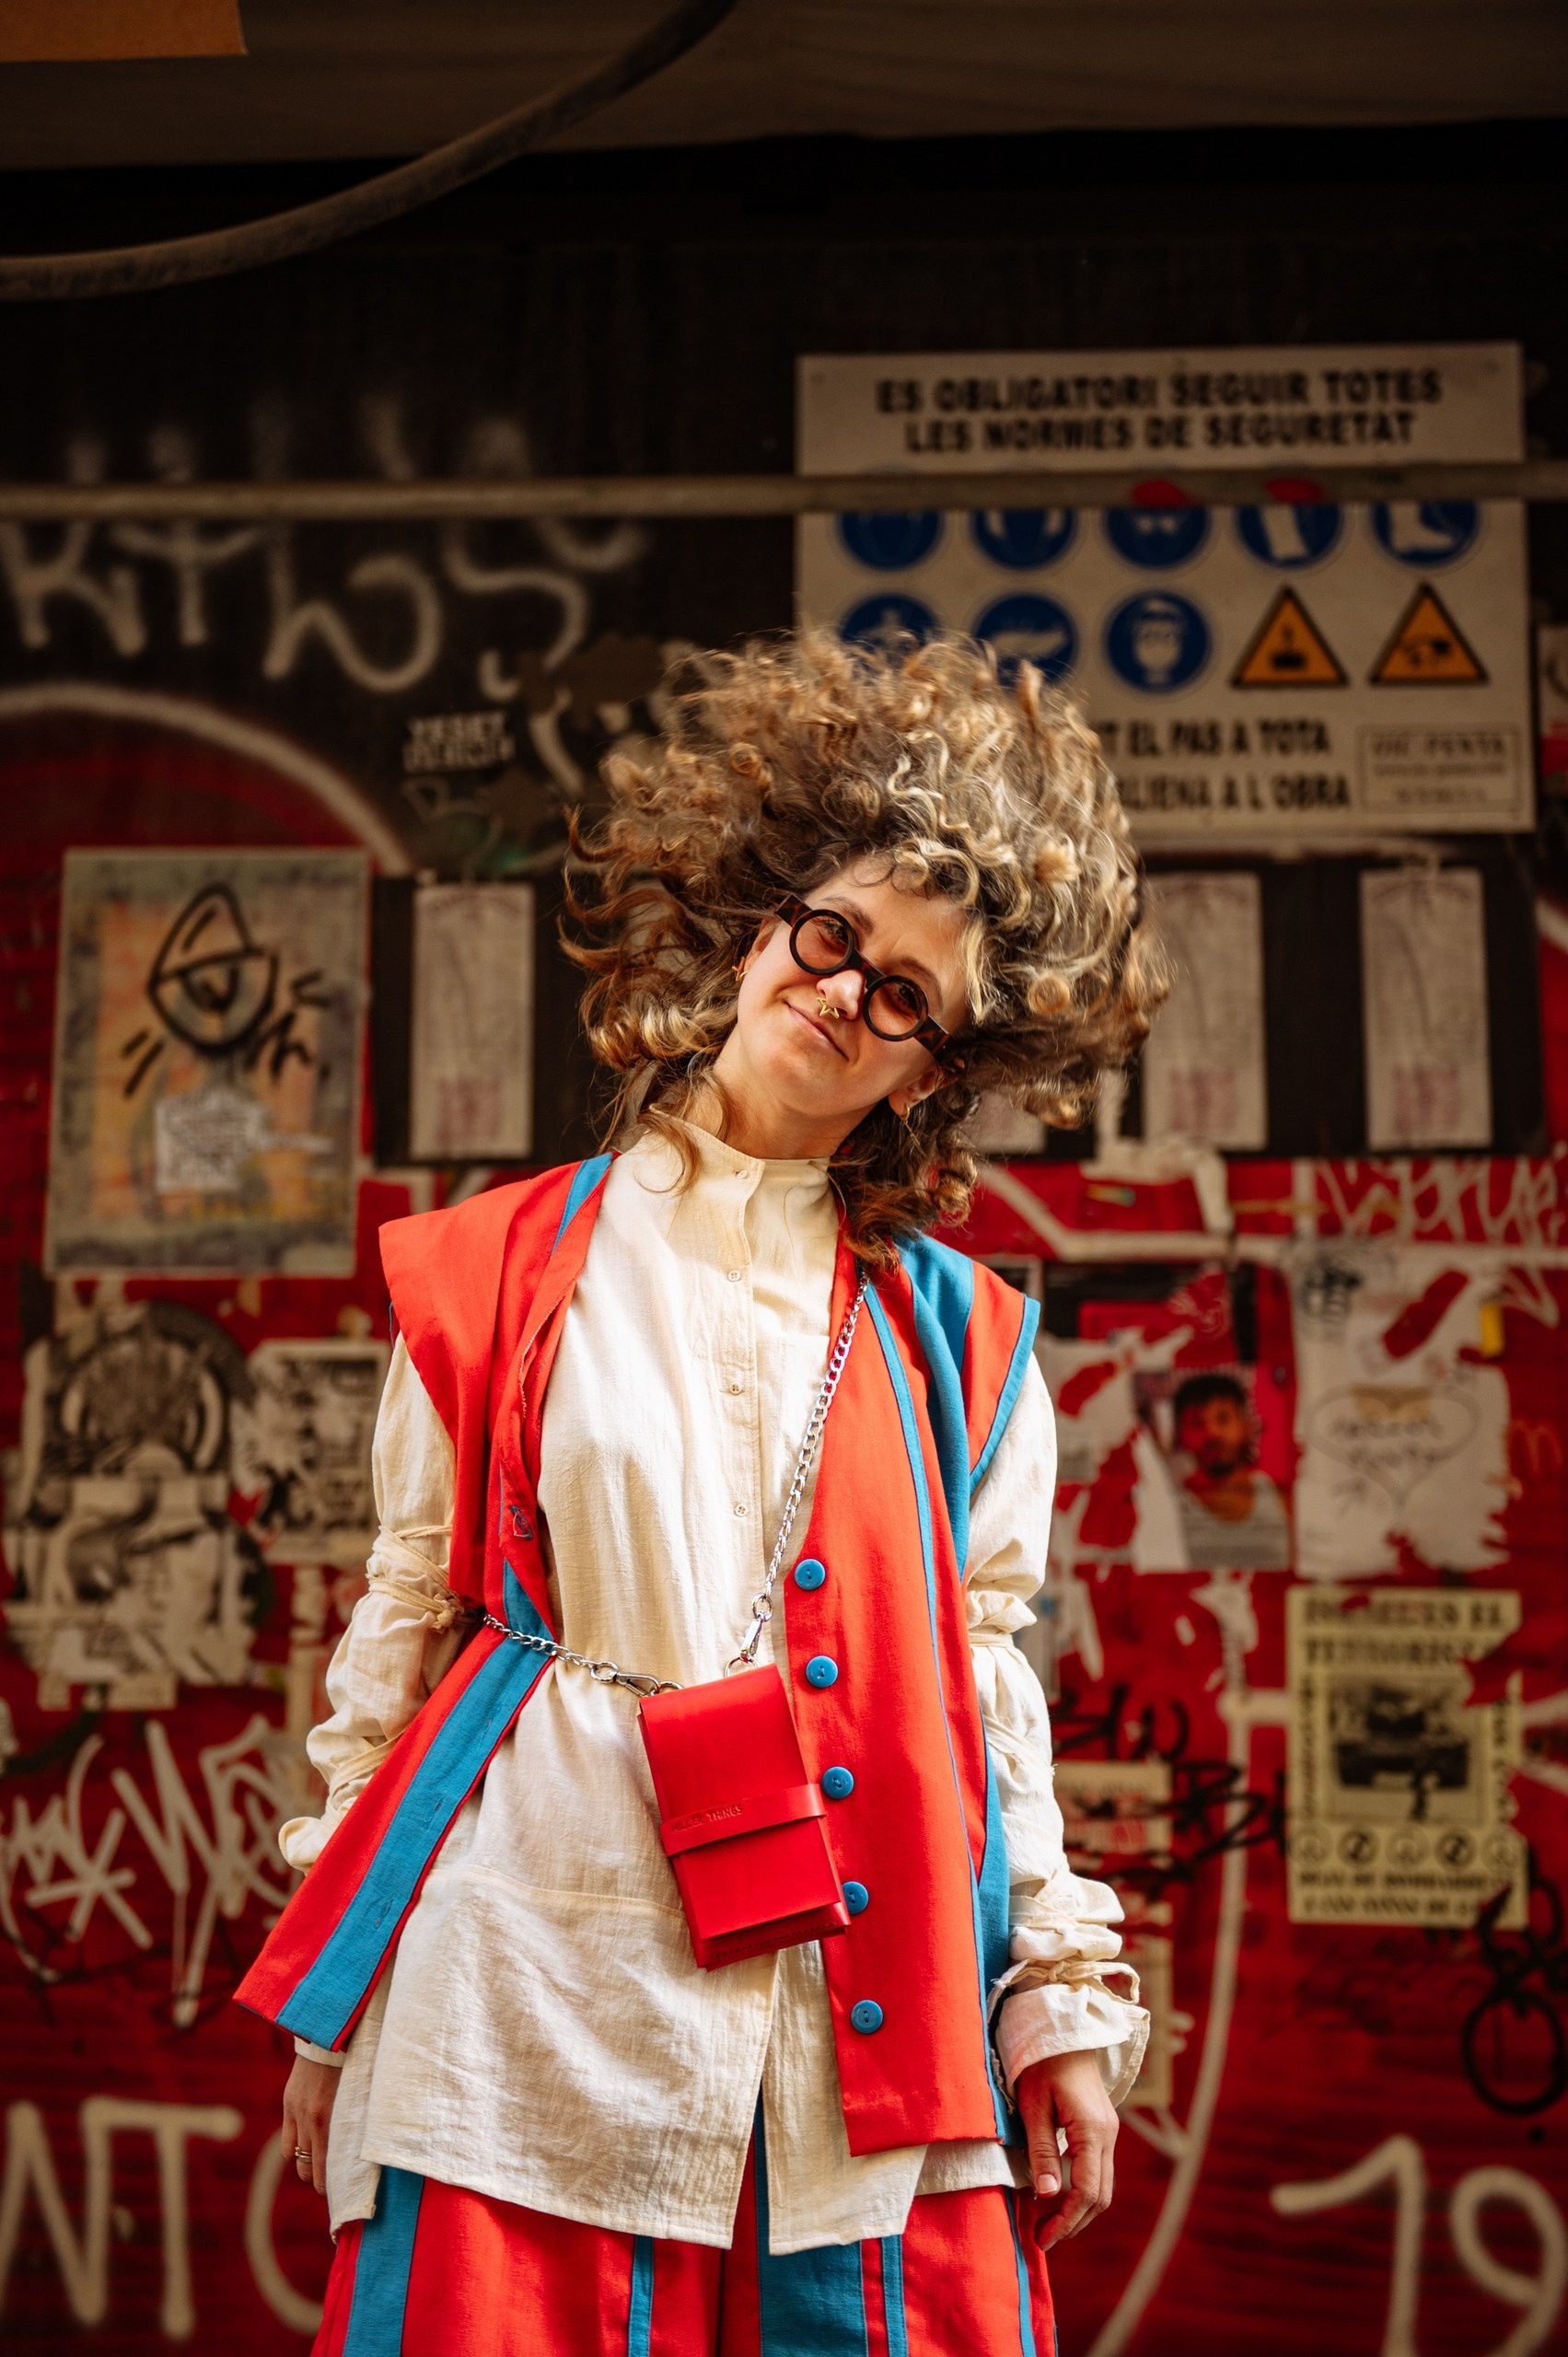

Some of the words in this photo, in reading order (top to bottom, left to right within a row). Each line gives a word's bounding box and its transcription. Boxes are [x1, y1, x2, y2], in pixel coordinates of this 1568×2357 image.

[877, 377, 921, 412] ES
[935, 375, 1157, 412] OBLIGATORI
[1170, 370, 1309, 406] SEGUIR
[1323, 367, 1443, 403] TOTES
[905, 419, 970, 453] LES
[983, 416, 1132, 451] NORMES
[1144, 414, 1191, 449] DE
[1204, 411, 1416, 447] SEGURETAT
[1127, 719, 1162, 757] EL
[1169, 719, 1222, 756] PAS
[1230, 719, 1249, 754] A
[1258, 718, 1331, 755] TOTA
[1221, 774, 1239, 809] A
[672, 1814, 704, 1833] MILLER
[706, 1805, 743, 1823] THINGS
